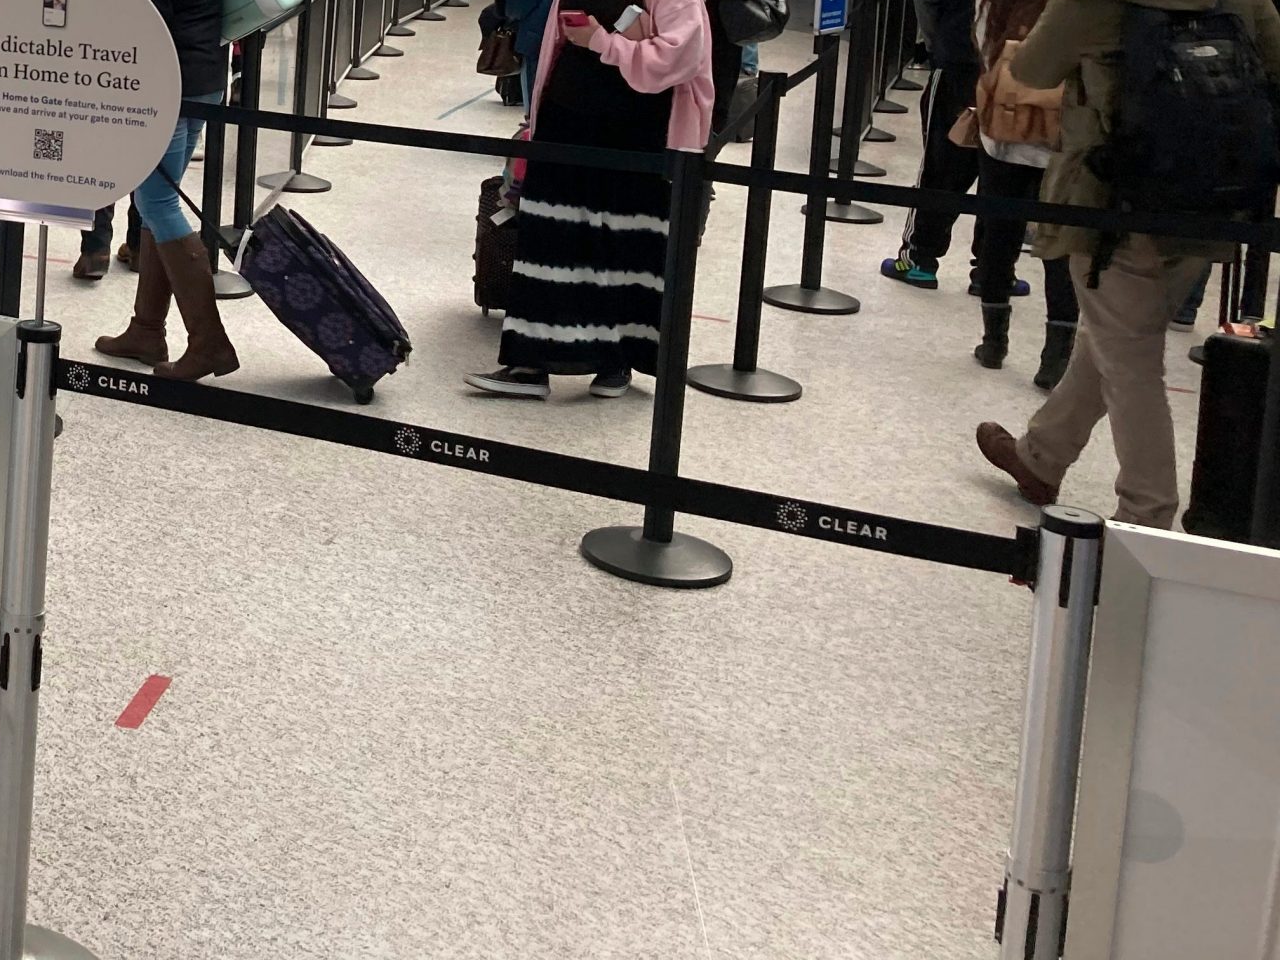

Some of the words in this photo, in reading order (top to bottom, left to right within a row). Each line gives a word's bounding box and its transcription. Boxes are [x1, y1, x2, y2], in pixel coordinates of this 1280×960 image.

[79, 43, 137, 64] Travel
[13, 63, 69, 84] Home
[74, 70, 92, 86] to
[97, 71, 140, 91] Gate
[2, 92, 28, 103] Home
[30, 95, 39, 103] to
[41, 96, 63, 106] Gate
[64, 98, 98, 110] feature,
[100, 102, 124, 112] know
[126, 106, 159, 118] exactly
[13, 106, 29, 115] and
[31, 108, 56, 118] arrive
[58, 111, 67, 119] at
[69, 113, 89, 121] your
[90, 114, 110, 124] gate
[111, 117, 123, 125] on
[125, 117, 148, 128] time.
[31, 171, 45, 180] the
[47, 172, 64, 183] free
[66, 175, 97, 186] CLEAR
[99, 180, 116, 190] app
[97, 375, 149, 396] CLEAR
[430, 439, 490, 463] CLEAR
[818, 515, 887, 540] CLEAR
